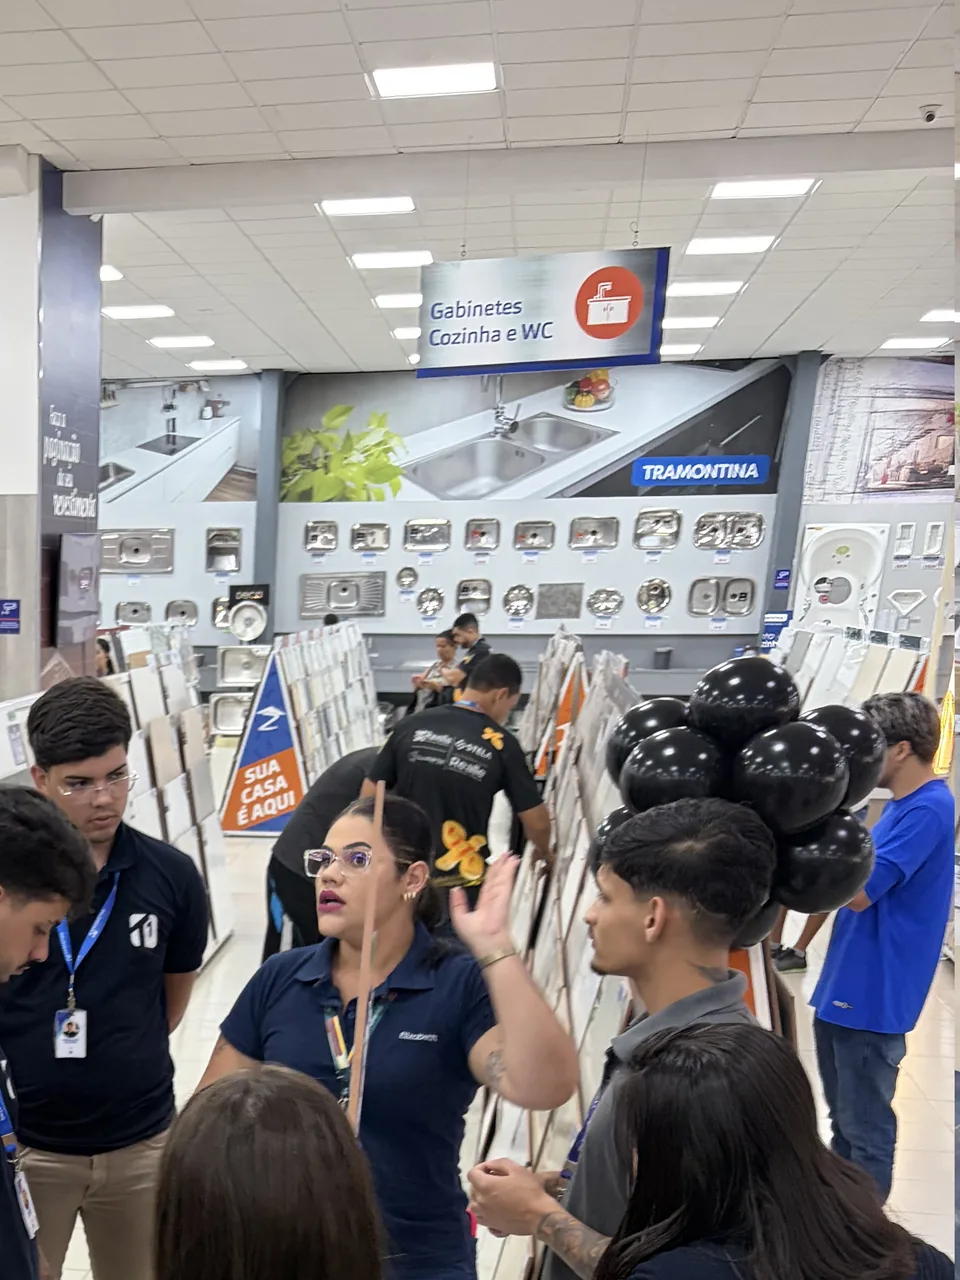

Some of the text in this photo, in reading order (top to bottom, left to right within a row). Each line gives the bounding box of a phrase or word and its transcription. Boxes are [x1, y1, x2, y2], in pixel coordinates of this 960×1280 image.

[430, 300, 522, 320] Gabinetes
[429, 321, 553, 346] Cozinha e WC
[642, 463, 759, 480] TRAMONTINA
[244, 759, 280, 784] SUA
[241, 775, 288, 804] CASA
[237, 790, 295, 826] É AQUI
